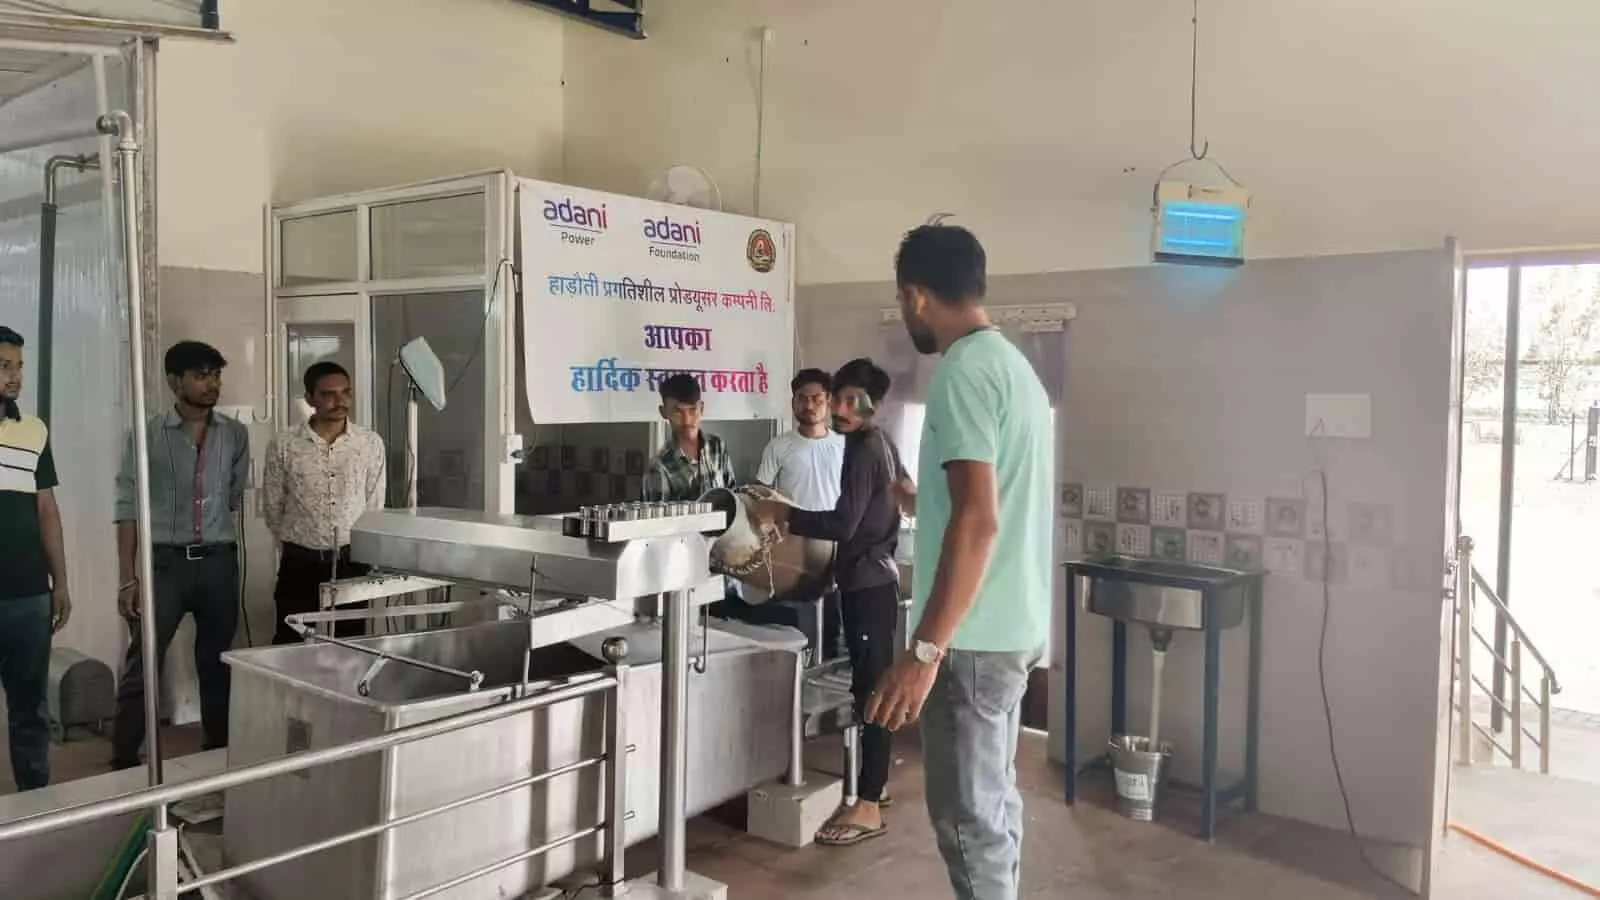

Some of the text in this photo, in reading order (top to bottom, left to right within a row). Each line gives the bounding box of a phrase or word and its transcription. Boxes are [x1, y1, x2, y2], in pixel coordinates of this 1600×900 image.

[543, 198, 607, 229] adani
[561, 231, 596, 246] Power
[643, 216, 701, 244] adani
[649, 246, 700, 262] Foundation
[603, 277, 664, 303] प्रगतिशील
[720, 289, 758, 311] कम्पनी
[644, 324, 712, 351] आपका
[569, 358, 641, 392] हार्दिक
[710, 370, 754, 392] करता
[755, 362, 769, 394] है
